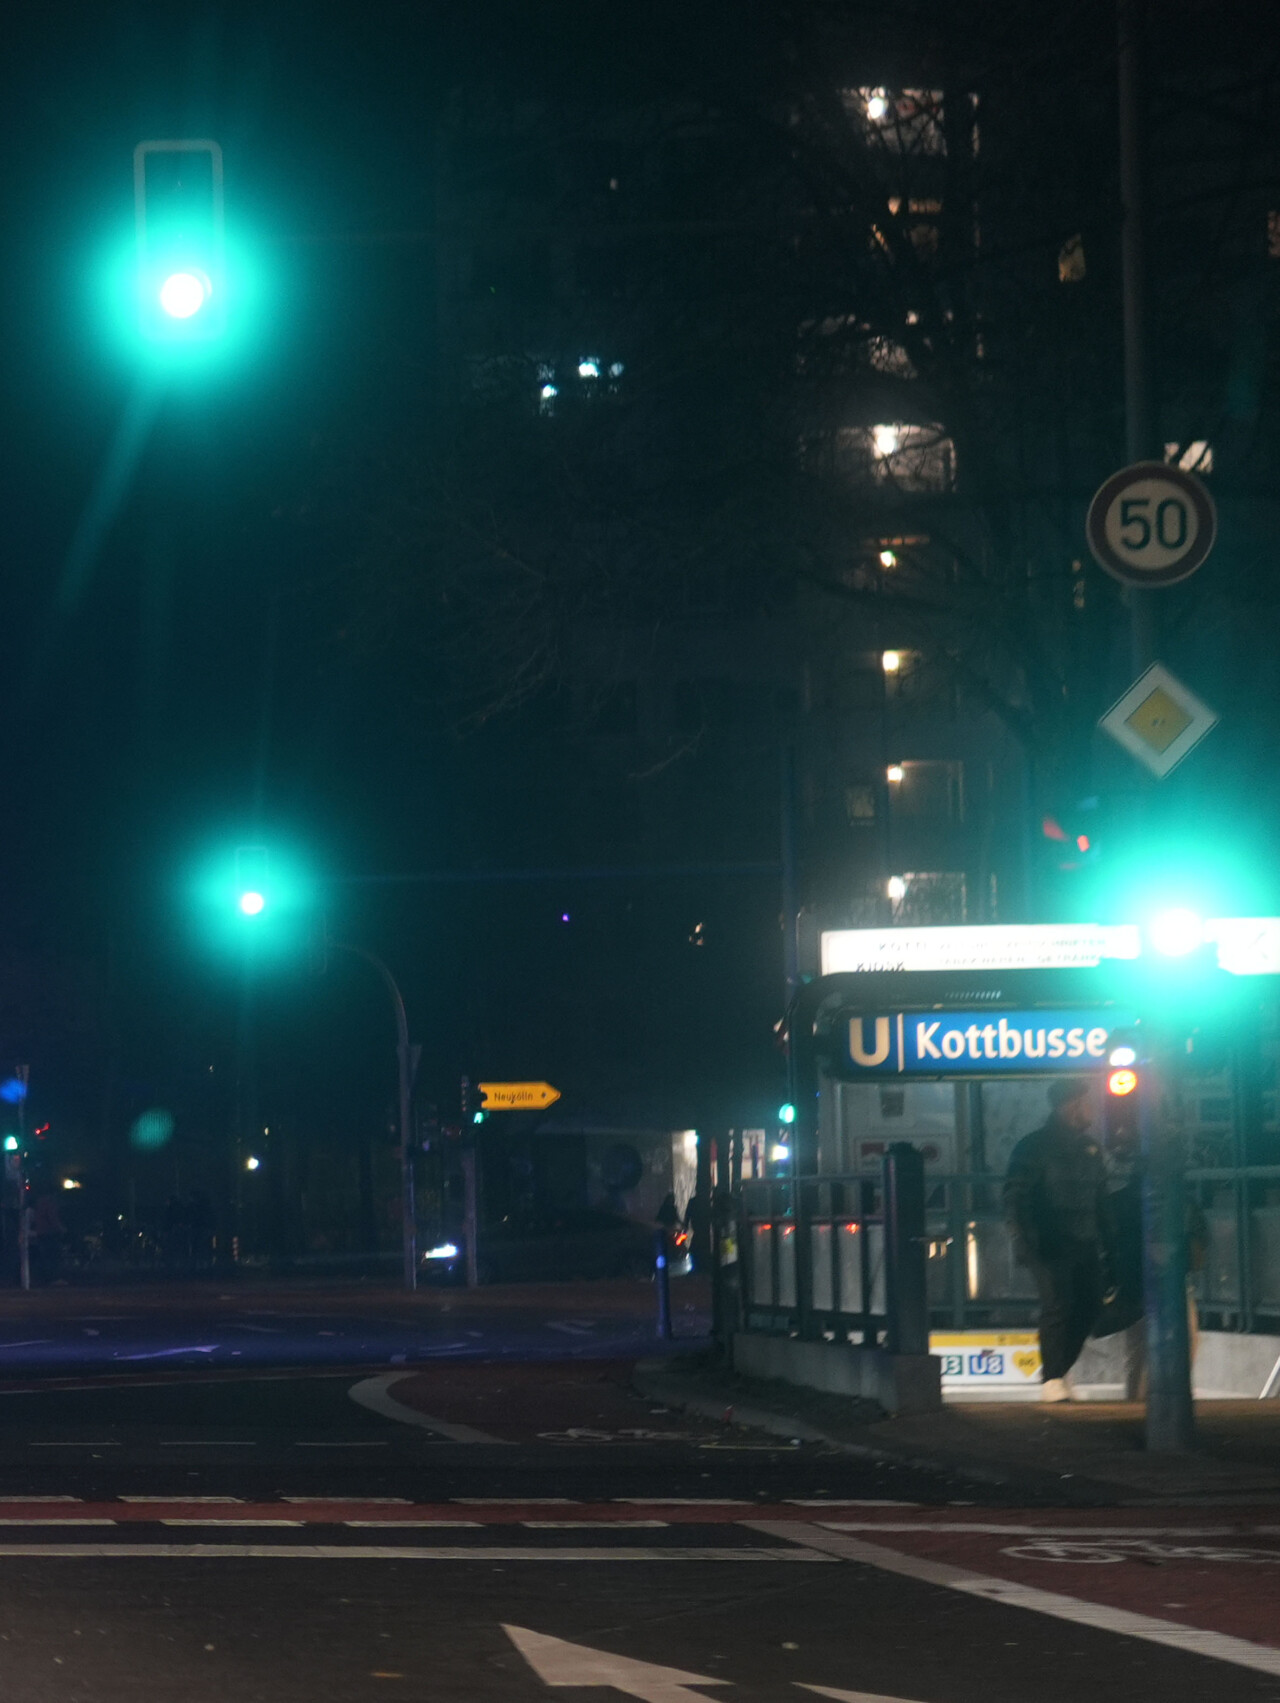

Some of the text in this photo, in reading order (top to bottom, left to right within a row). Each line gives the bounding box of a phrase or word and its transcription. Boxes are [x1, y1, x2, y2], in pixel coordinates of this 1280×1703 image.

[1120, 498, 1187, 550] 50
[849, 1016, 1108, 1067] U Kottbusse
[494, 1091, 533, 1102] Neukölln
[971, 1355, 1002, 1375] U8
